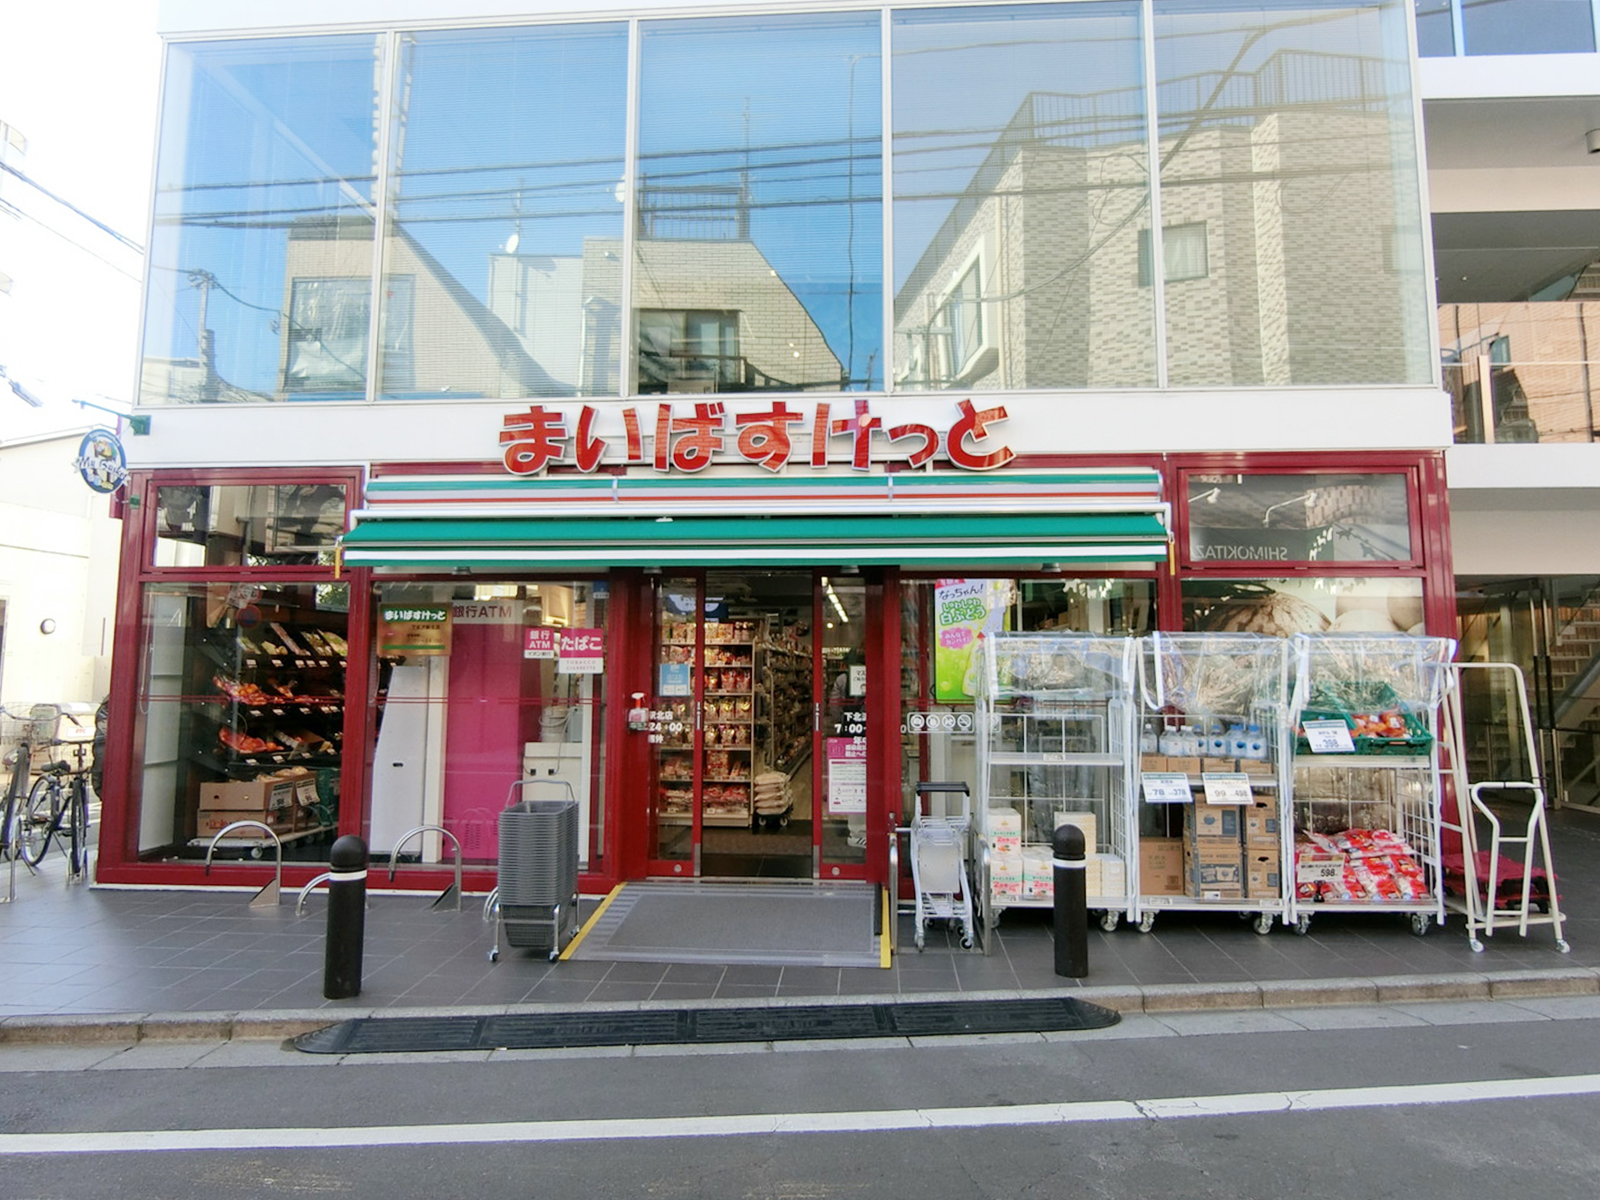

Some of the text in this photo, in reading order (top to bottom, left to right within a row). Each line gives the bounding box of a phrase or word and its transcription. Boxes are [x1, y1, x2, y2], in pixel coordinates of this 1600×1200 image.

[498, 398, 1017, 476] まいばすけっと
[384, 609, 447, 621] まいばすけっと
[453, 605, 512, 618] 銀行ATM
[530, 630, 550, 640] 銀行
[529, 640, 551, 649] ATM
[561, 636, 603, 651] たばこ
[1152, 788, 1165, 796] 78
[1214, 789, 1226, 797] 99
[1320, 868, 1336, 877] 598
